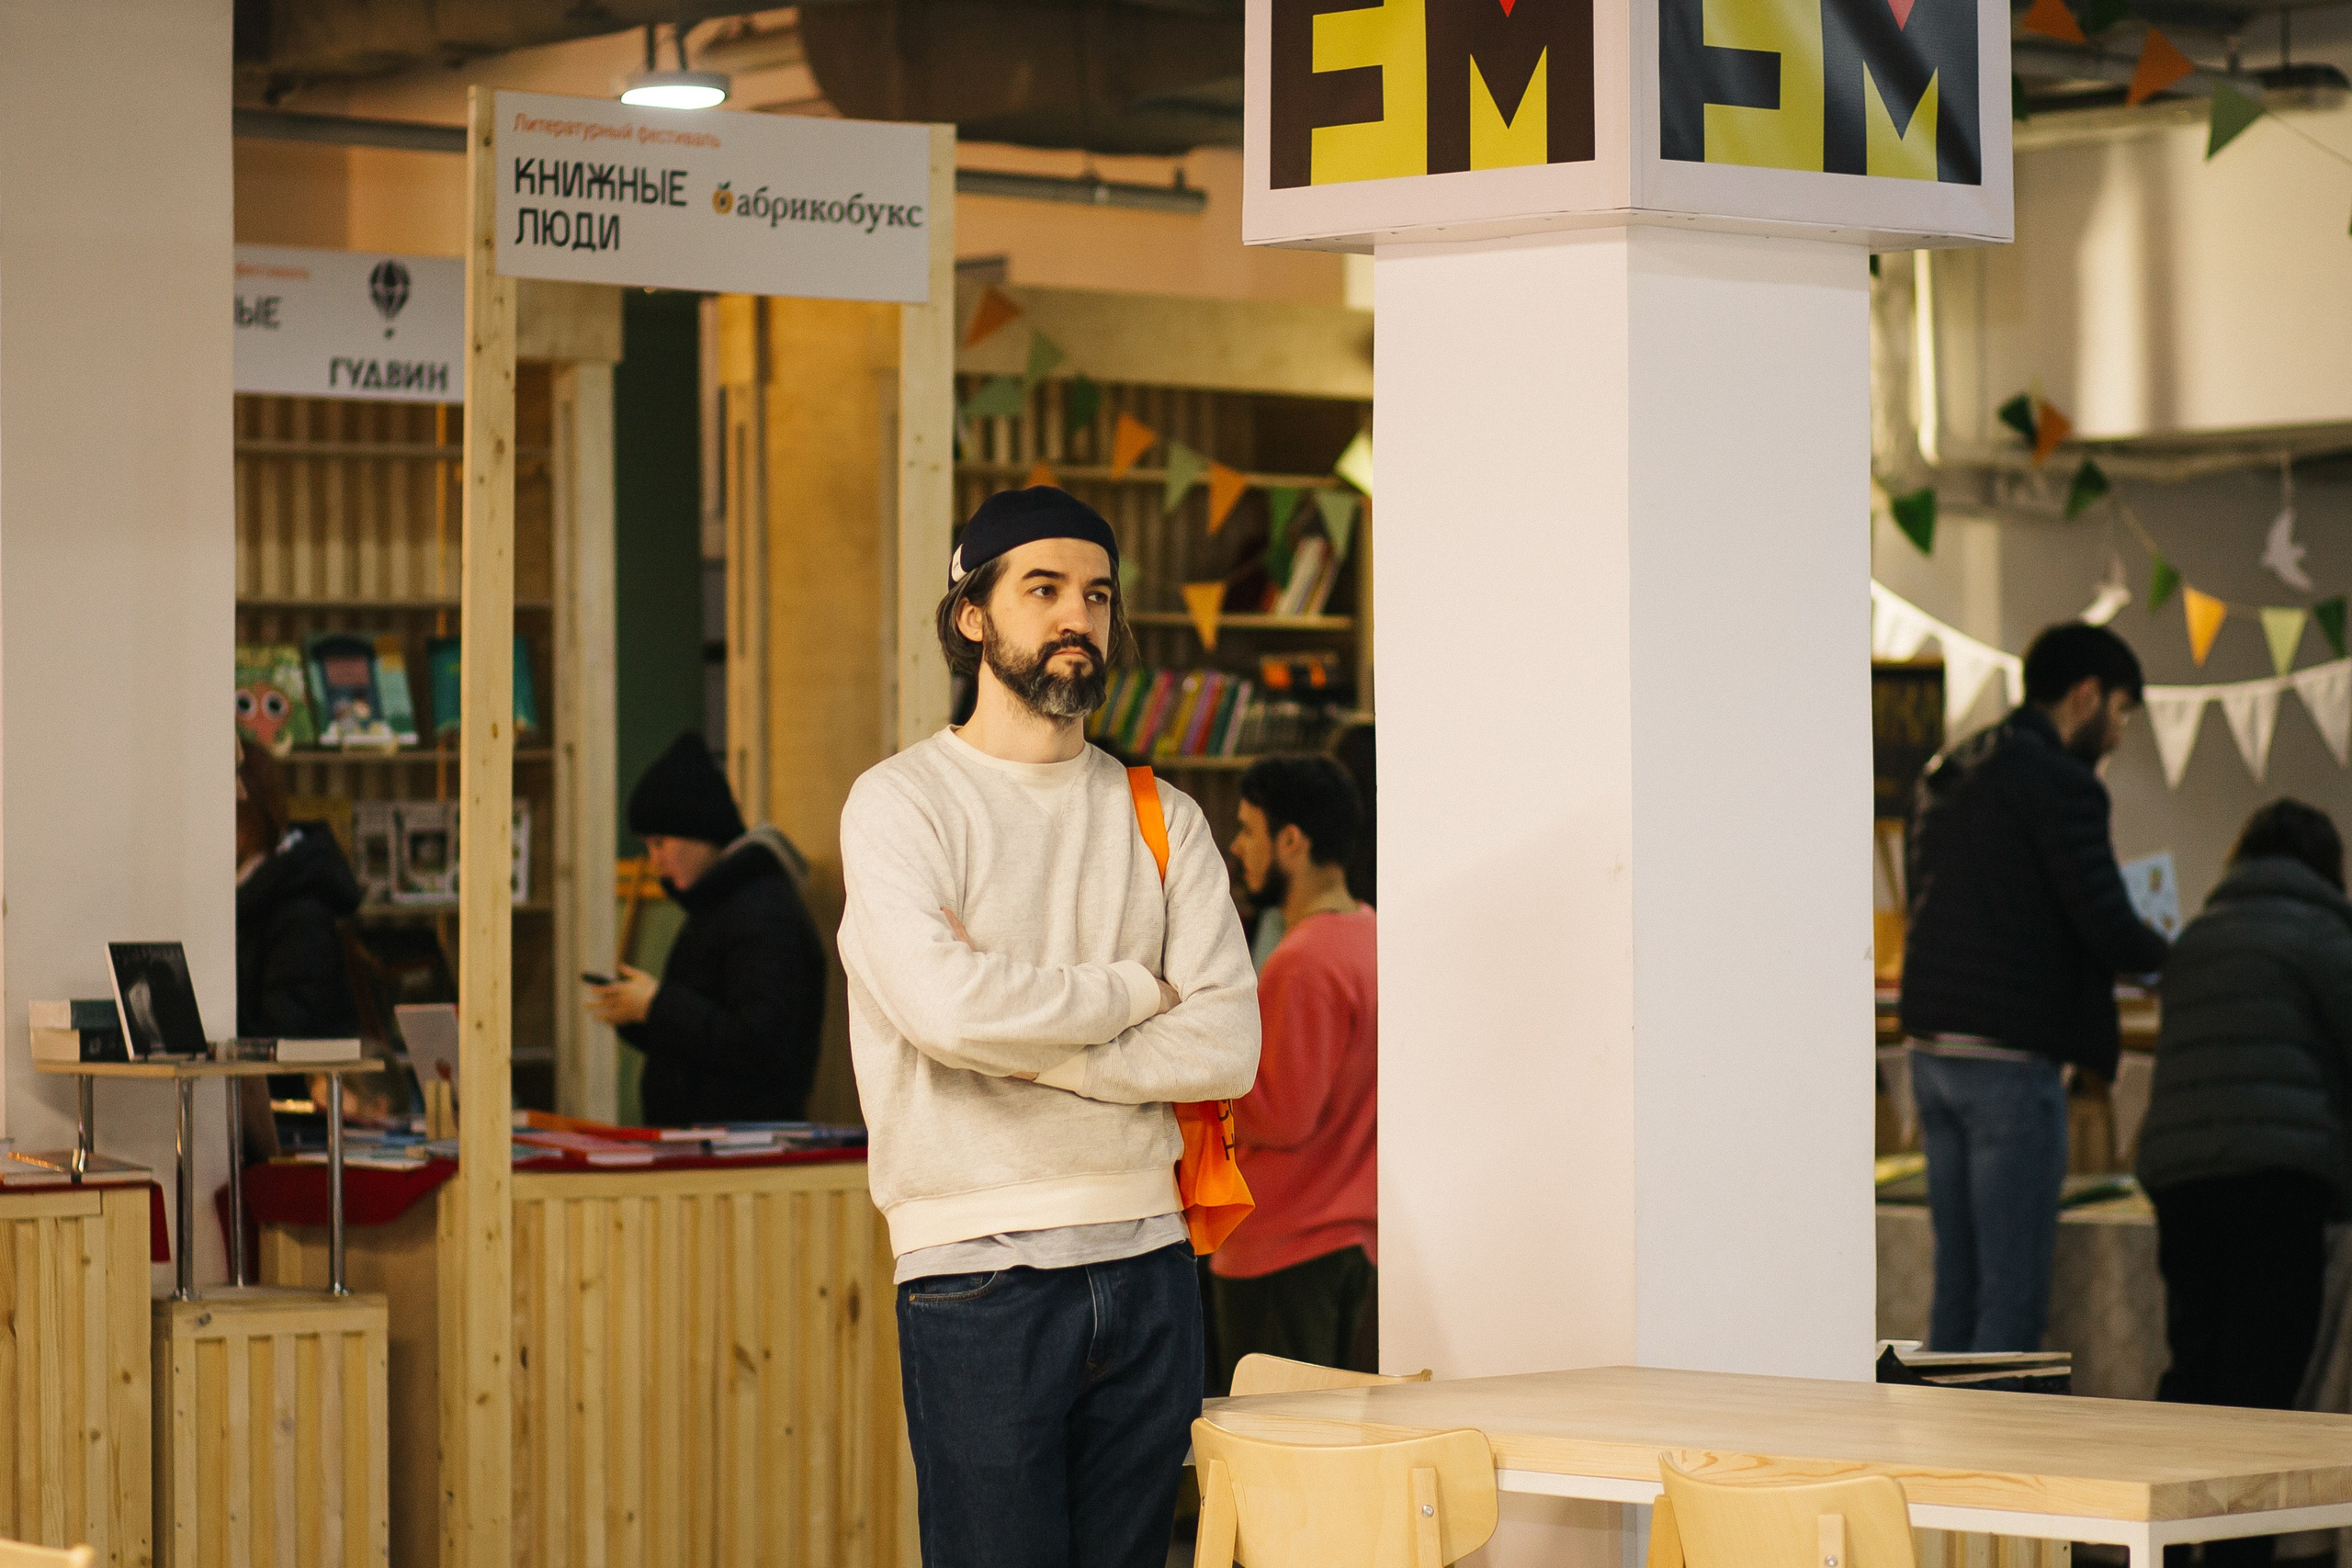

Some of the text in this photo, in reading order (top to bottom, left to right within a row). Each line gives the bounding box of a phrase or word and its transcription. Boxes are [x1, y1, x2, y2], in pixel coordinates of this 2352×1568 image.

[514, 156, 689, 208] КНИЖНЫЕ
[514, 208, 621, 253] ЛЮДИ
[233, 294, 281, 331] ЫЕ
